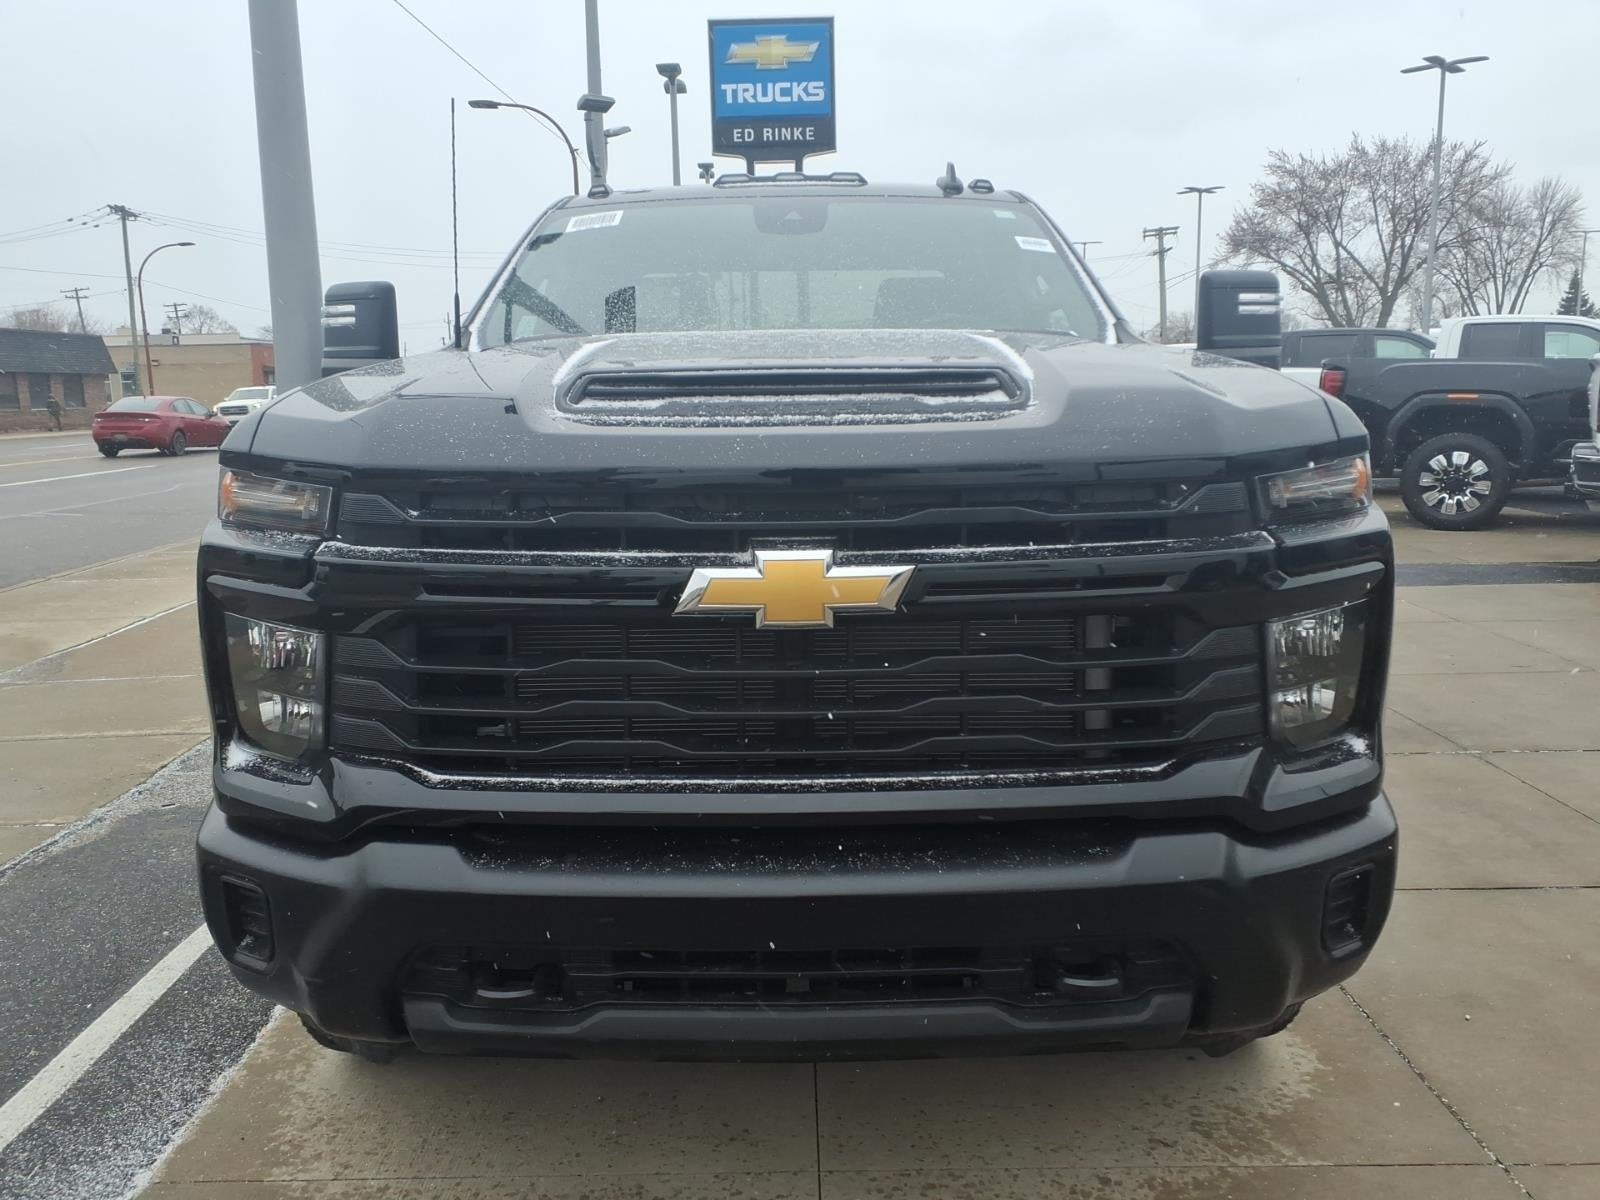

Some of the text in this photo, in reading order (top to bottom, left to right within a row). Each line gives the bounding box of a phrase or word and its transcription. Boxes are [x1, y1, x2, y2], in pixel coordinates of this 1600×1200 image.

[721, 81, 825, 104] TRUCKS
[733, 127, 815, 142] ED RINKE
